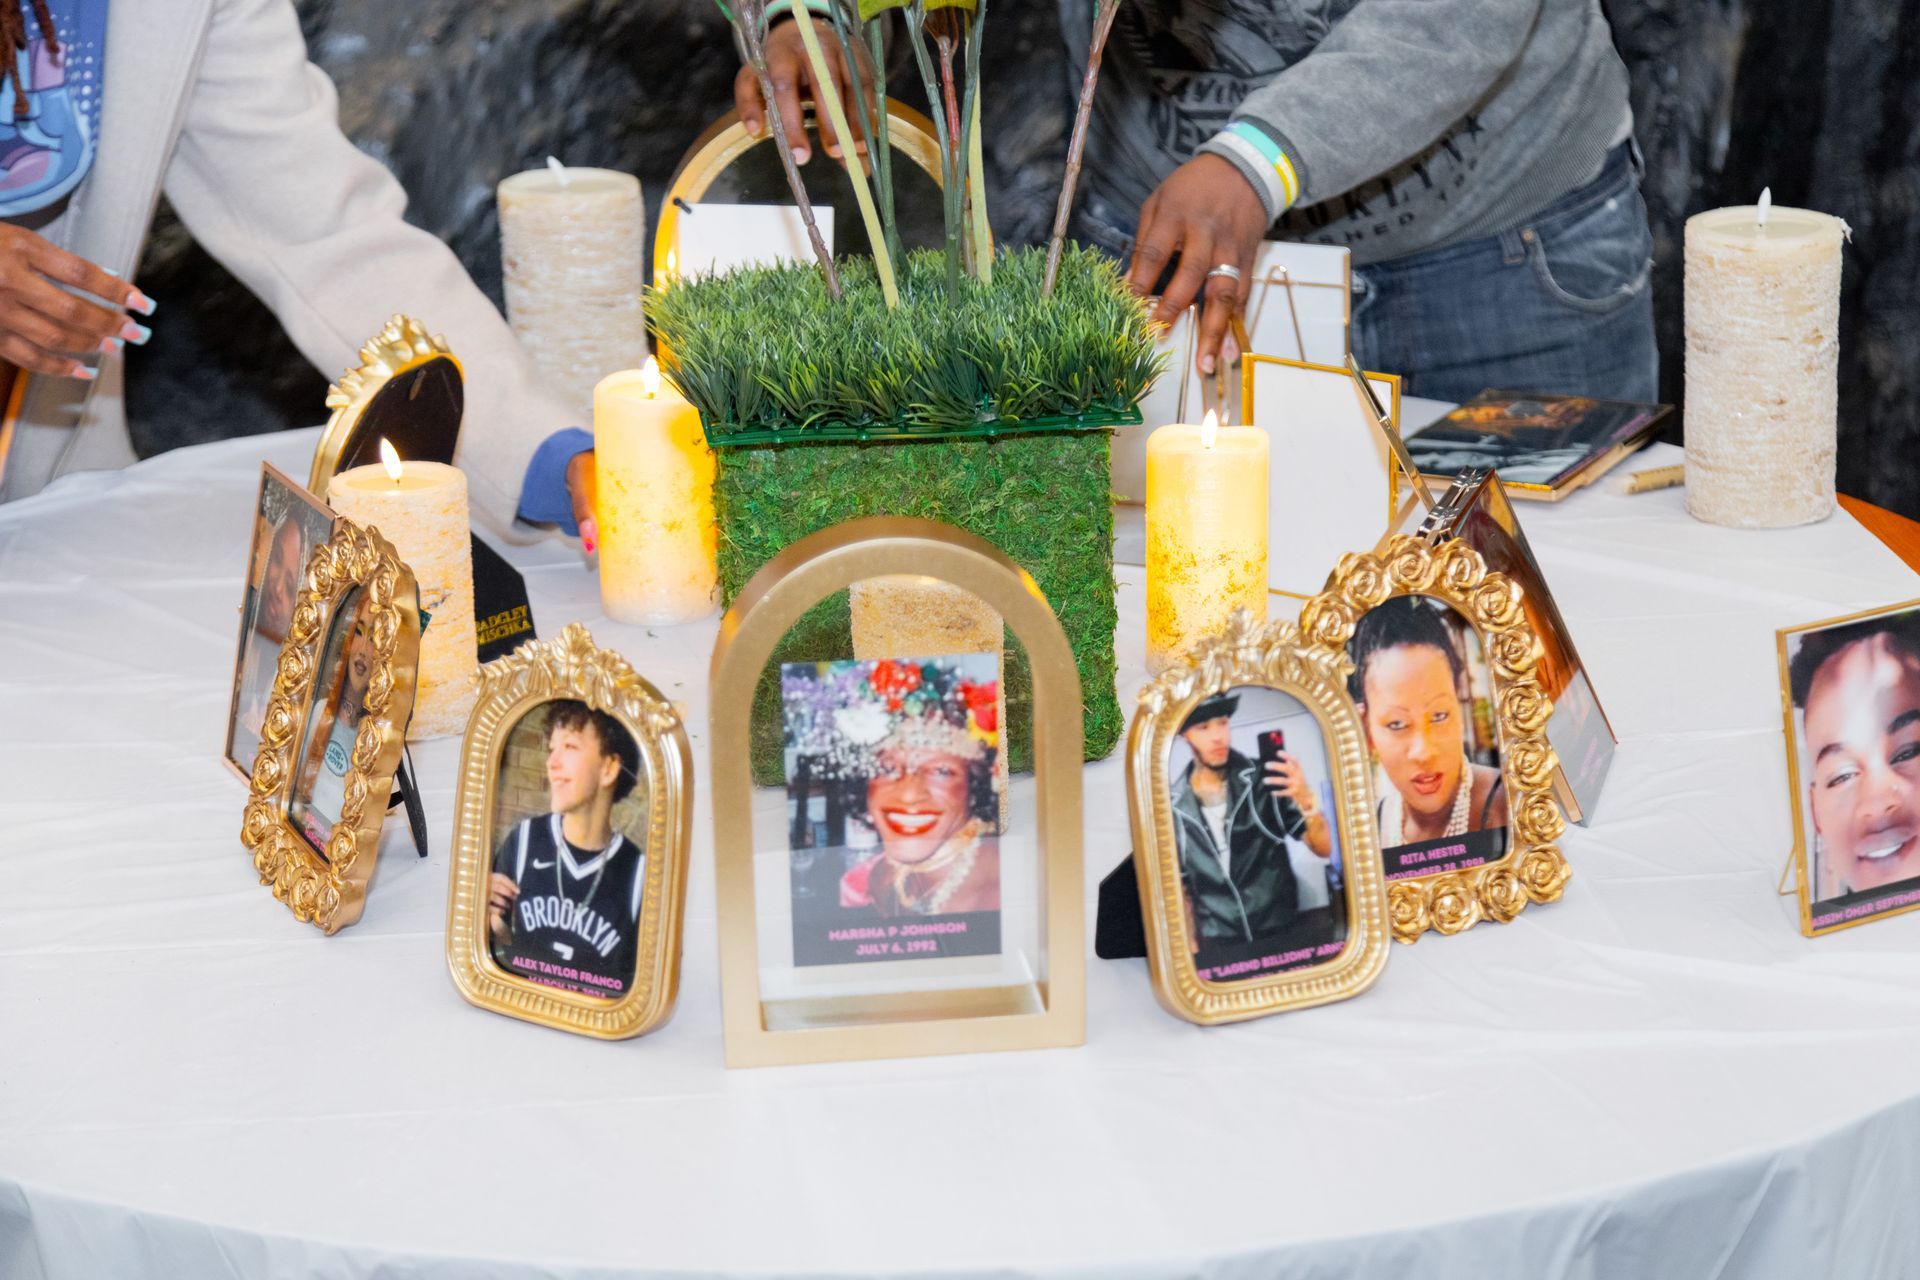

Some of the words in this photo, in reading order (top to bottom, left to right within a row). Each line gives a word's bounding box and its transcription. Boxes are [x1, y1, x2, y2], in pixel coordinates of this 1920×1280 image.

[1400, 851, 1426, 866] RITA
[1427, 843, 1467, 860] HESTER
[520, 895, 622, 958] BROOKLYN
[828, 927, 886, 941] MARSHA
[888, 926, 898, 937] P
[900, 922, 968, 936] JOHNSON
[856, 943, 889, 956] JULY
[906, 940, 937, 952] 1992
[512, 955, 538, 971] ALEX
[540, 961, 578, 980] TAYLOR
[579, 970, 623, 991] FRANCO
